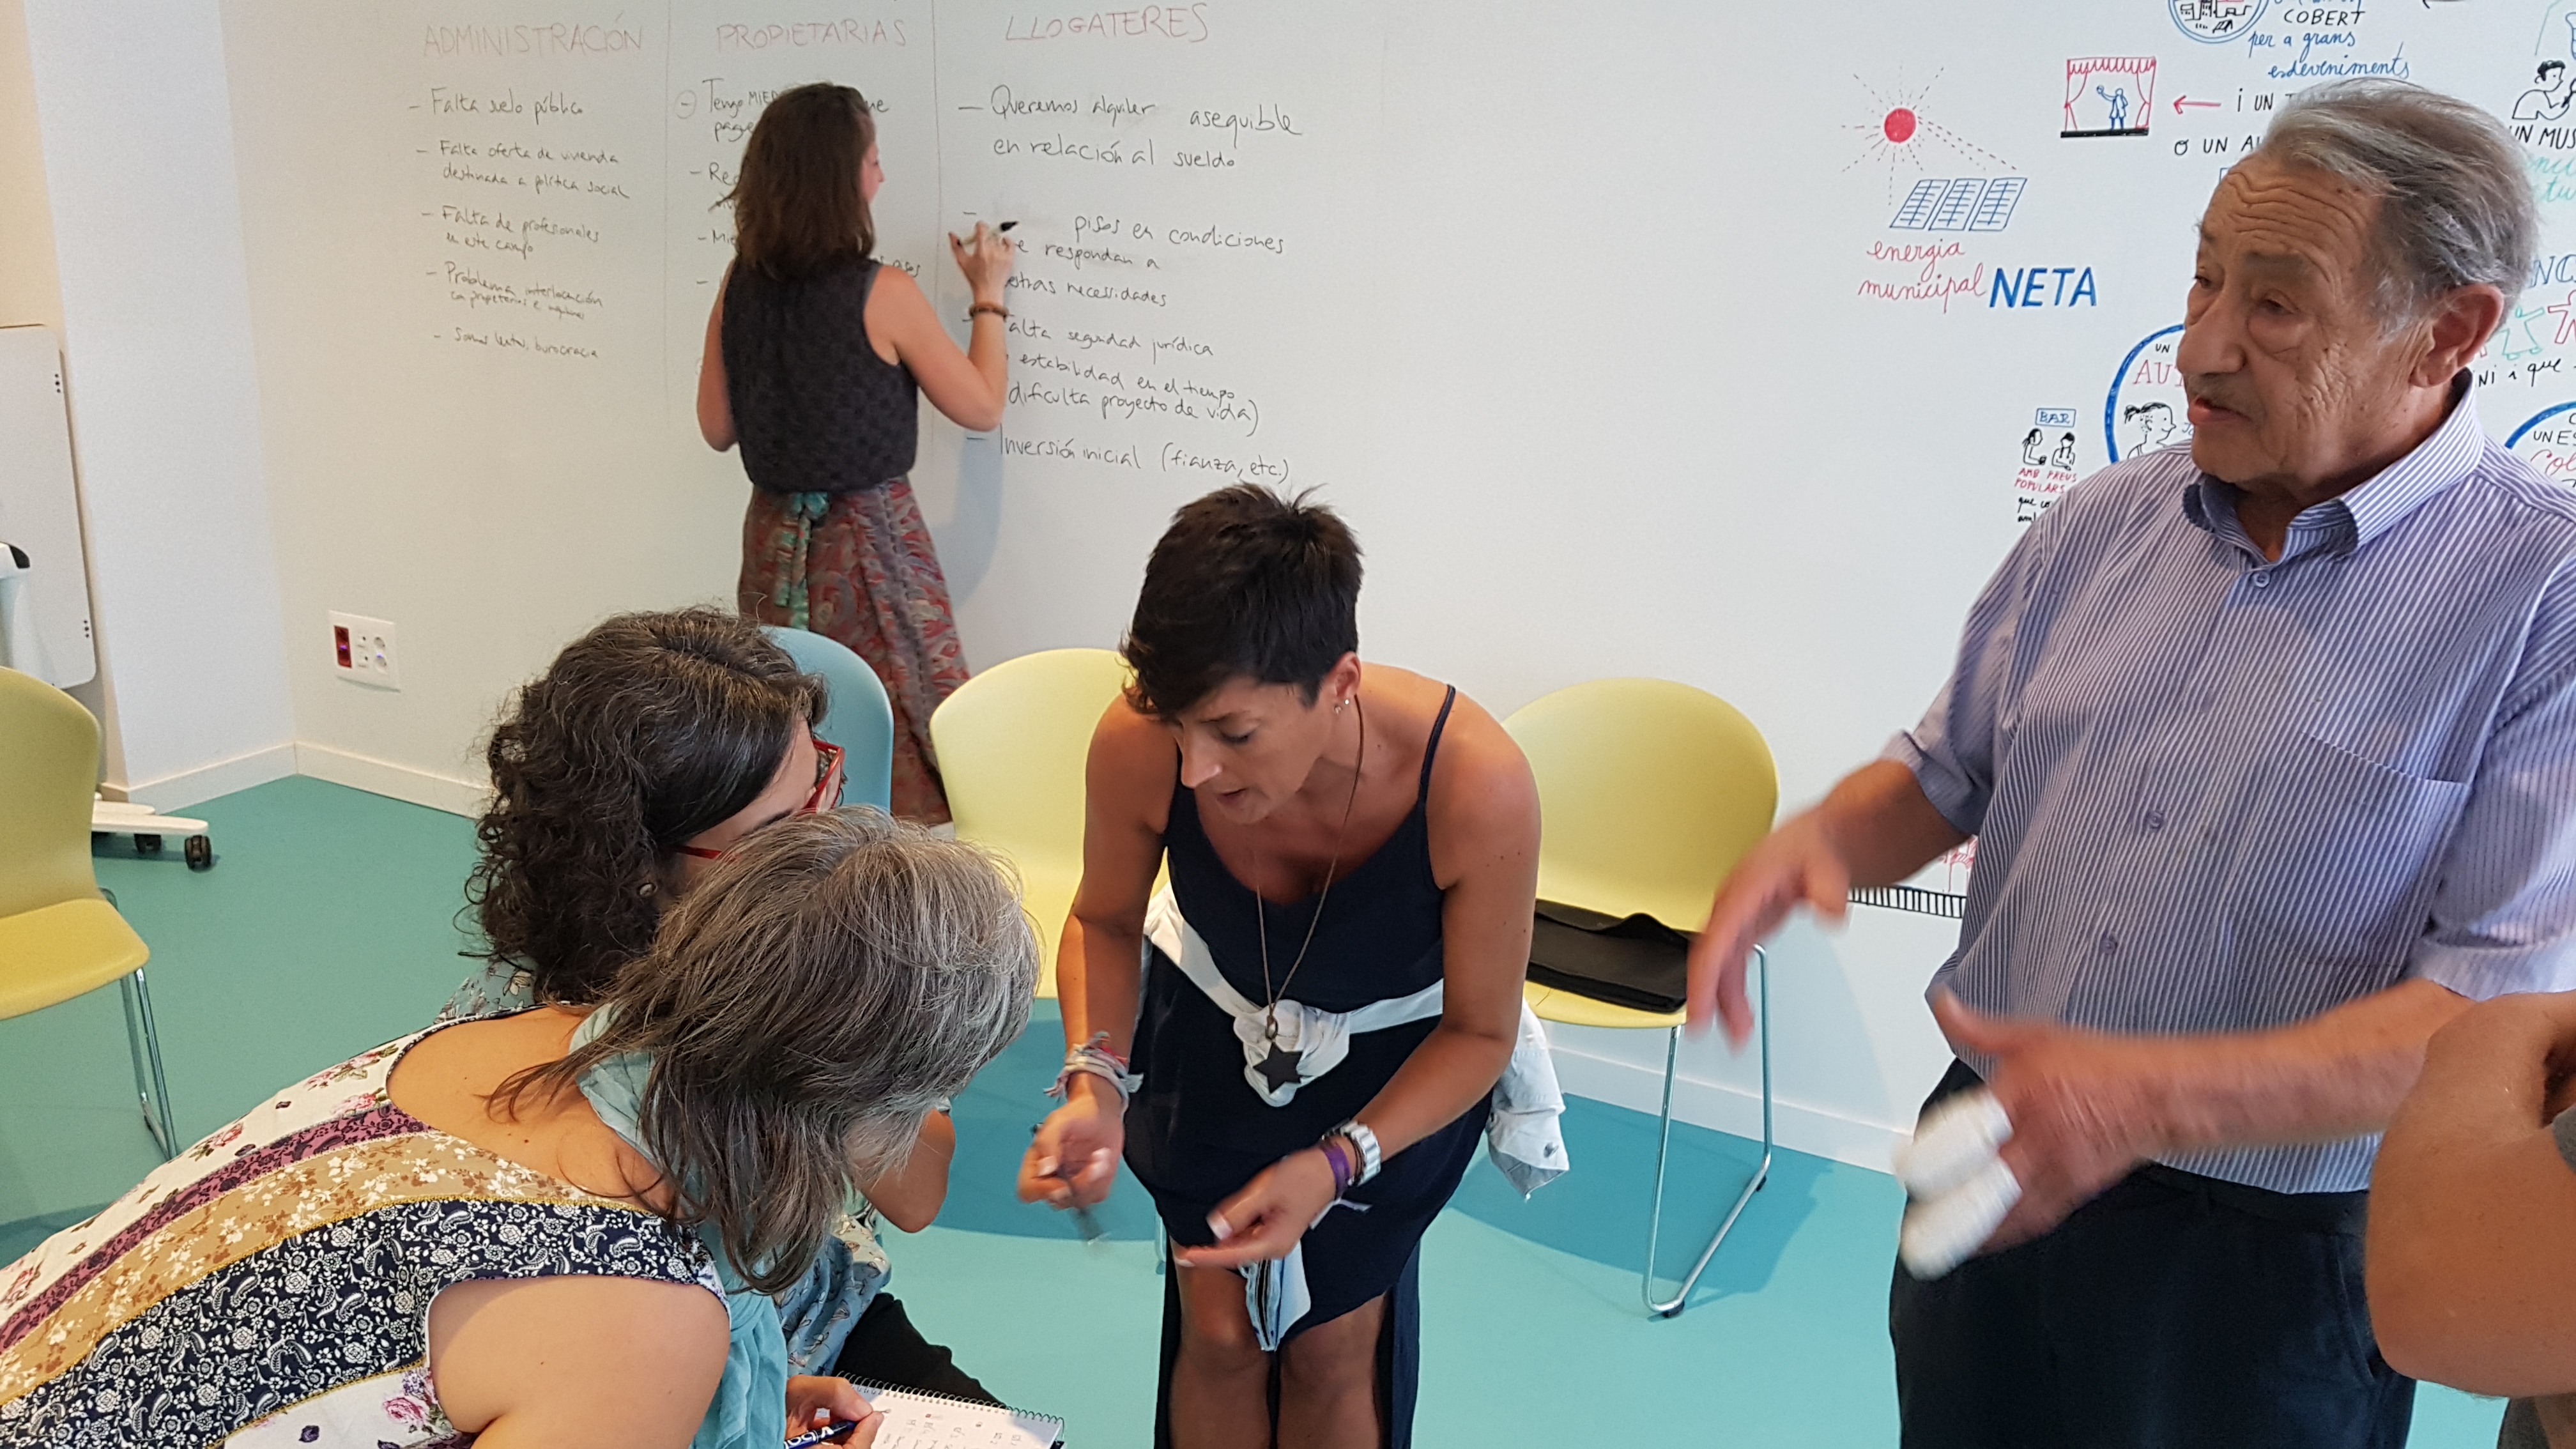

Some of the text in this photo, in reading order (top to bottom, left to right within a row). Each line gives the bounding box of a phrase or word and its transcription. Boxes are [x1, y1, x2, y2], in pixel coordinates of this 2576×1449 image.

[1006, 3, 1209, 43] LLOGATERES
[2283, 8, 2366, 26] COBERT
[424, 12, 643, 57] ADMINISTRACIÓN
[716, 18, 906, 53] PROPIETARIAS
[2248, 31, 2356, 64] per a grans
[2268, 41, 2410, 79] esdeveniments
[431, 87, 480, 115] Falta
[2254, 92, 2274, 111] UN
[991, 84, 1078, 116] Queremos
[1190, 104, 1303, 148] asequible
[440, 139, 478, 157] Falta
[489, 142, 530, 159] oferta
[537, 146, 553, 160] de
[993, 132, 1235, 167] en relación al sueldo
[2203, 136, 2228, 153] UN
[442, 205, 489, 226] Falta
[496, 213, 513, 233] de
[1075, 216, 1284, 254] pisos en condiciones
[1045, 243, 1133, 270] respondan
[1147, 257, 1161, 270] a
[1867, 238, 1965, 283] energia
[445, 261, 516, 295] Problema
[1858, 262, 2097, 314] municipal NETA
[1152, 336, 1214, 365] jurídica
[2156, 343, 2170, 353] UN
[1138, 376, 1156, 391] en
[1164, 378, 1180, 395] el
[2527, 358, 2561, 387] que
[1101, 395, 1168, 419] proyecto
[1175, 399, 1199, 418] de
[2039, 411, 2071, 424] BAR
[1000, 422, 1075, 459] Inversión
[1083, 445, 1141, 469] inicial
[2014, 477, 2066, 493] POPULARS
[2018, 468, 2077, 482] AMB PREUS
